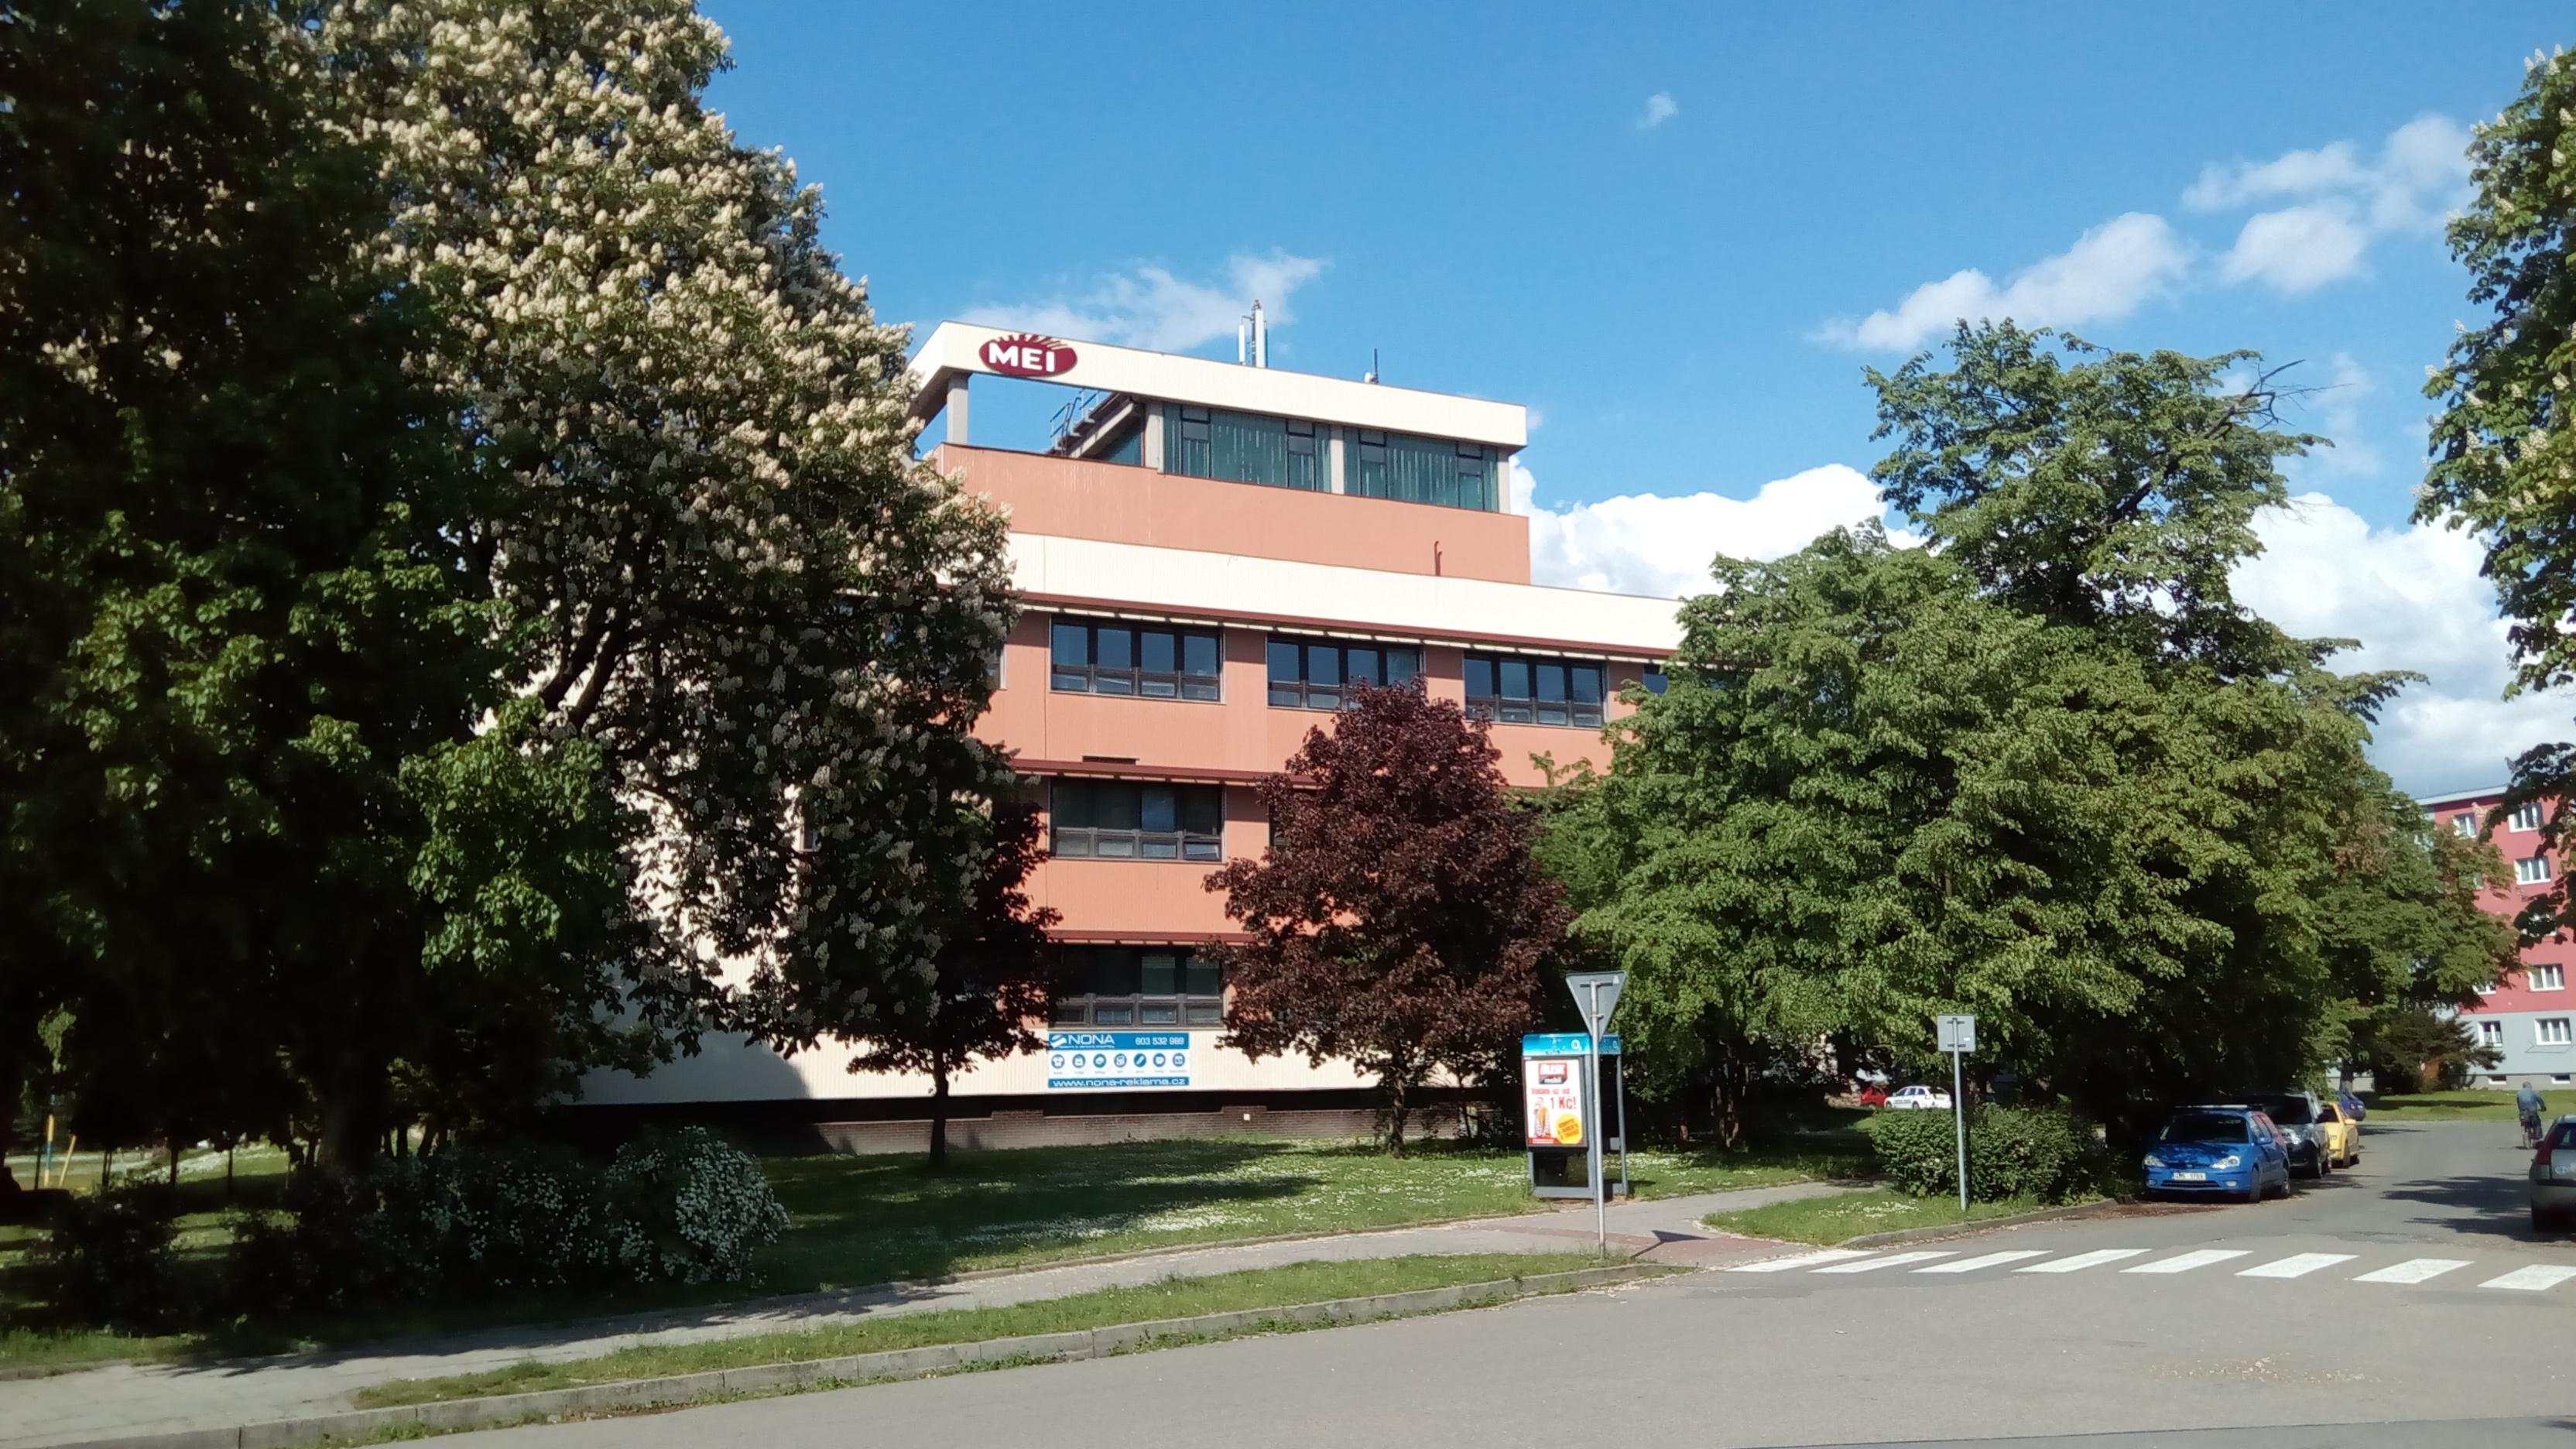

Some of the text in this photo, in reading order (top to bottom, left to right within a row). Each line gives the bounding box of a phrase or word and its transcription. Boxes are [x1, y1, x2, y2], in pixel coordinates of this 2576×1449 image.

[988, 342, 1055, 372] MEI
[1068, 1034, 1115, 1045] NONA
[1135, 1036, 1150, 1045] 603
[1052, 1077, 1186, 1088] www.nona-reklama.cz
